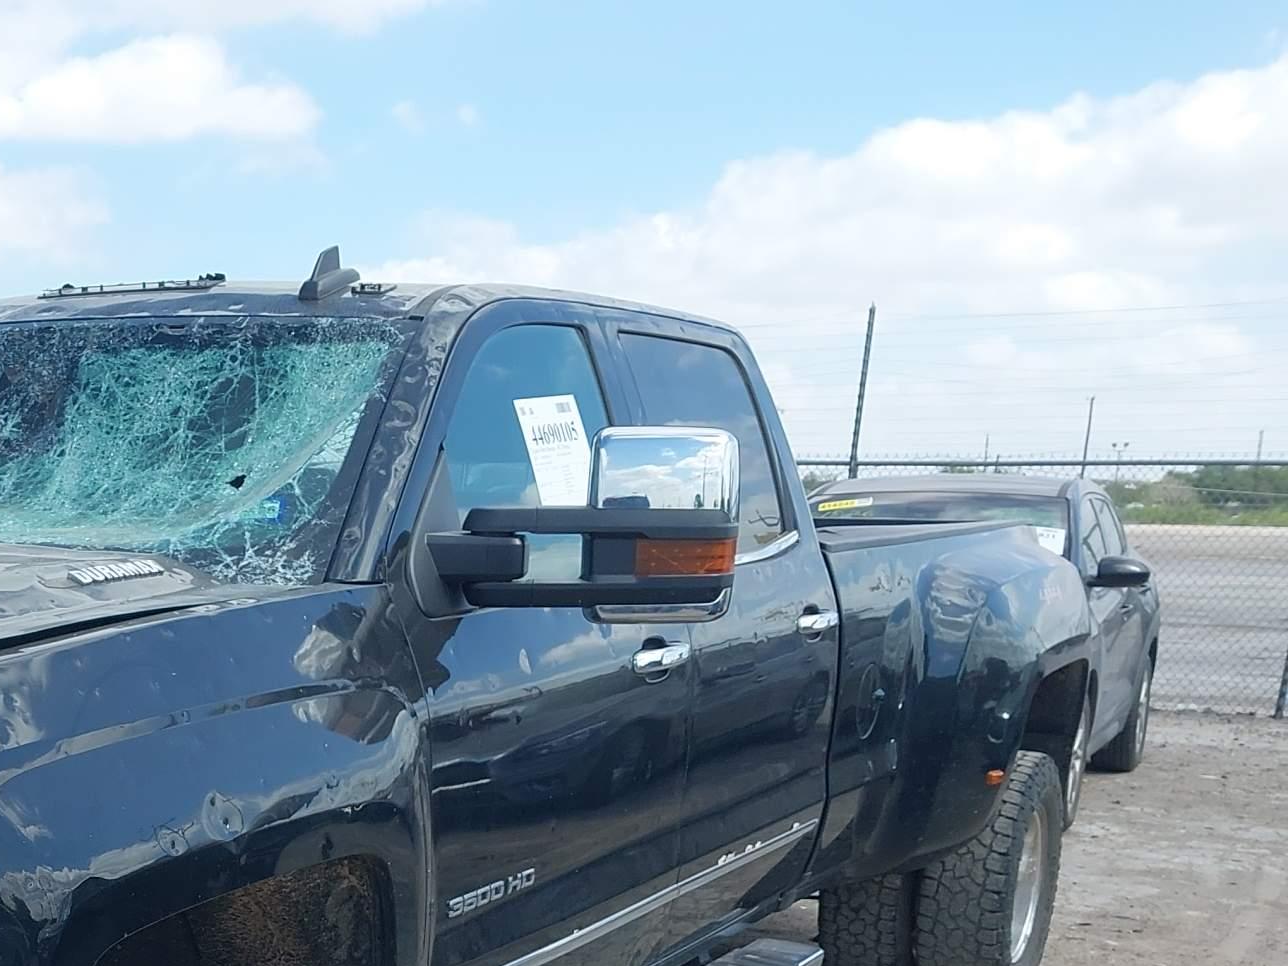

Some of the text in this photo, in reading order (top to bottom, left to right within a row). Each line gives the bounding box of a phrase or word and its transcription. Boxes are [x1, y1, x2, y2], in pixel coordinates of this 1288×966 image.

[532, 421, 579, 445] 44690105
[68, 560, 165, 584] DURAMAX
[447, 867, 536, 918] 3500 HD
